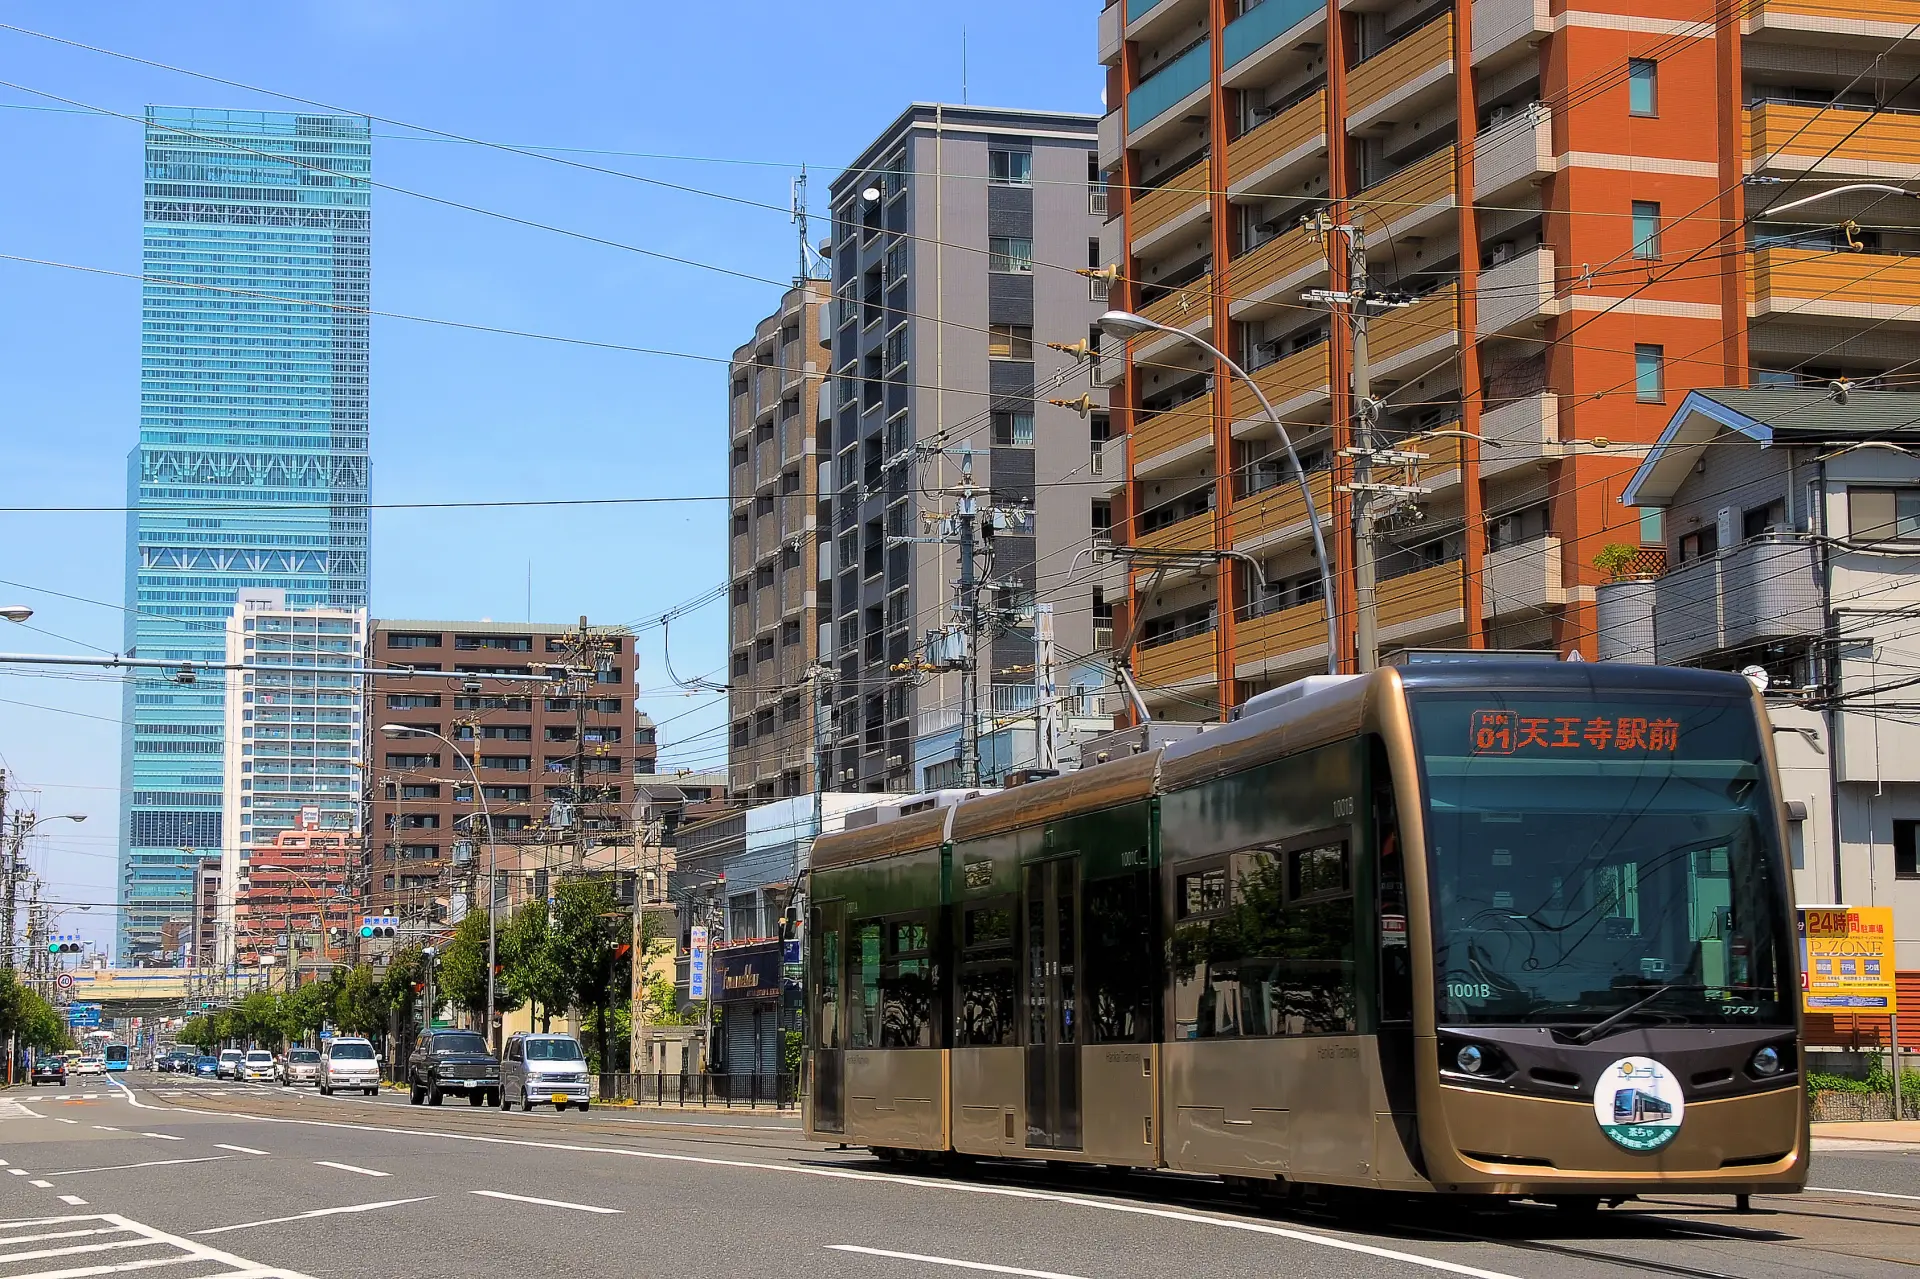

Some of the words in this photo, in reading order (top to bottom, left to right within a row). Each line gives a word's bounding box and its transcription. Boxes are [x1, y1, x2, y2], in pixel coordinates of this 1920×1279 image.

[1477, 728, 1510, 749] 01
[1517, 717, 1680, 751] 天王寺駅前
[1808, 912, 1860, 933] 24時間
[1810, 940, 1884, 957] P.ZONE
[1446, 983, 1491, 998] 1001B
[1721, 1005, 1759, 1015] ワンマン
